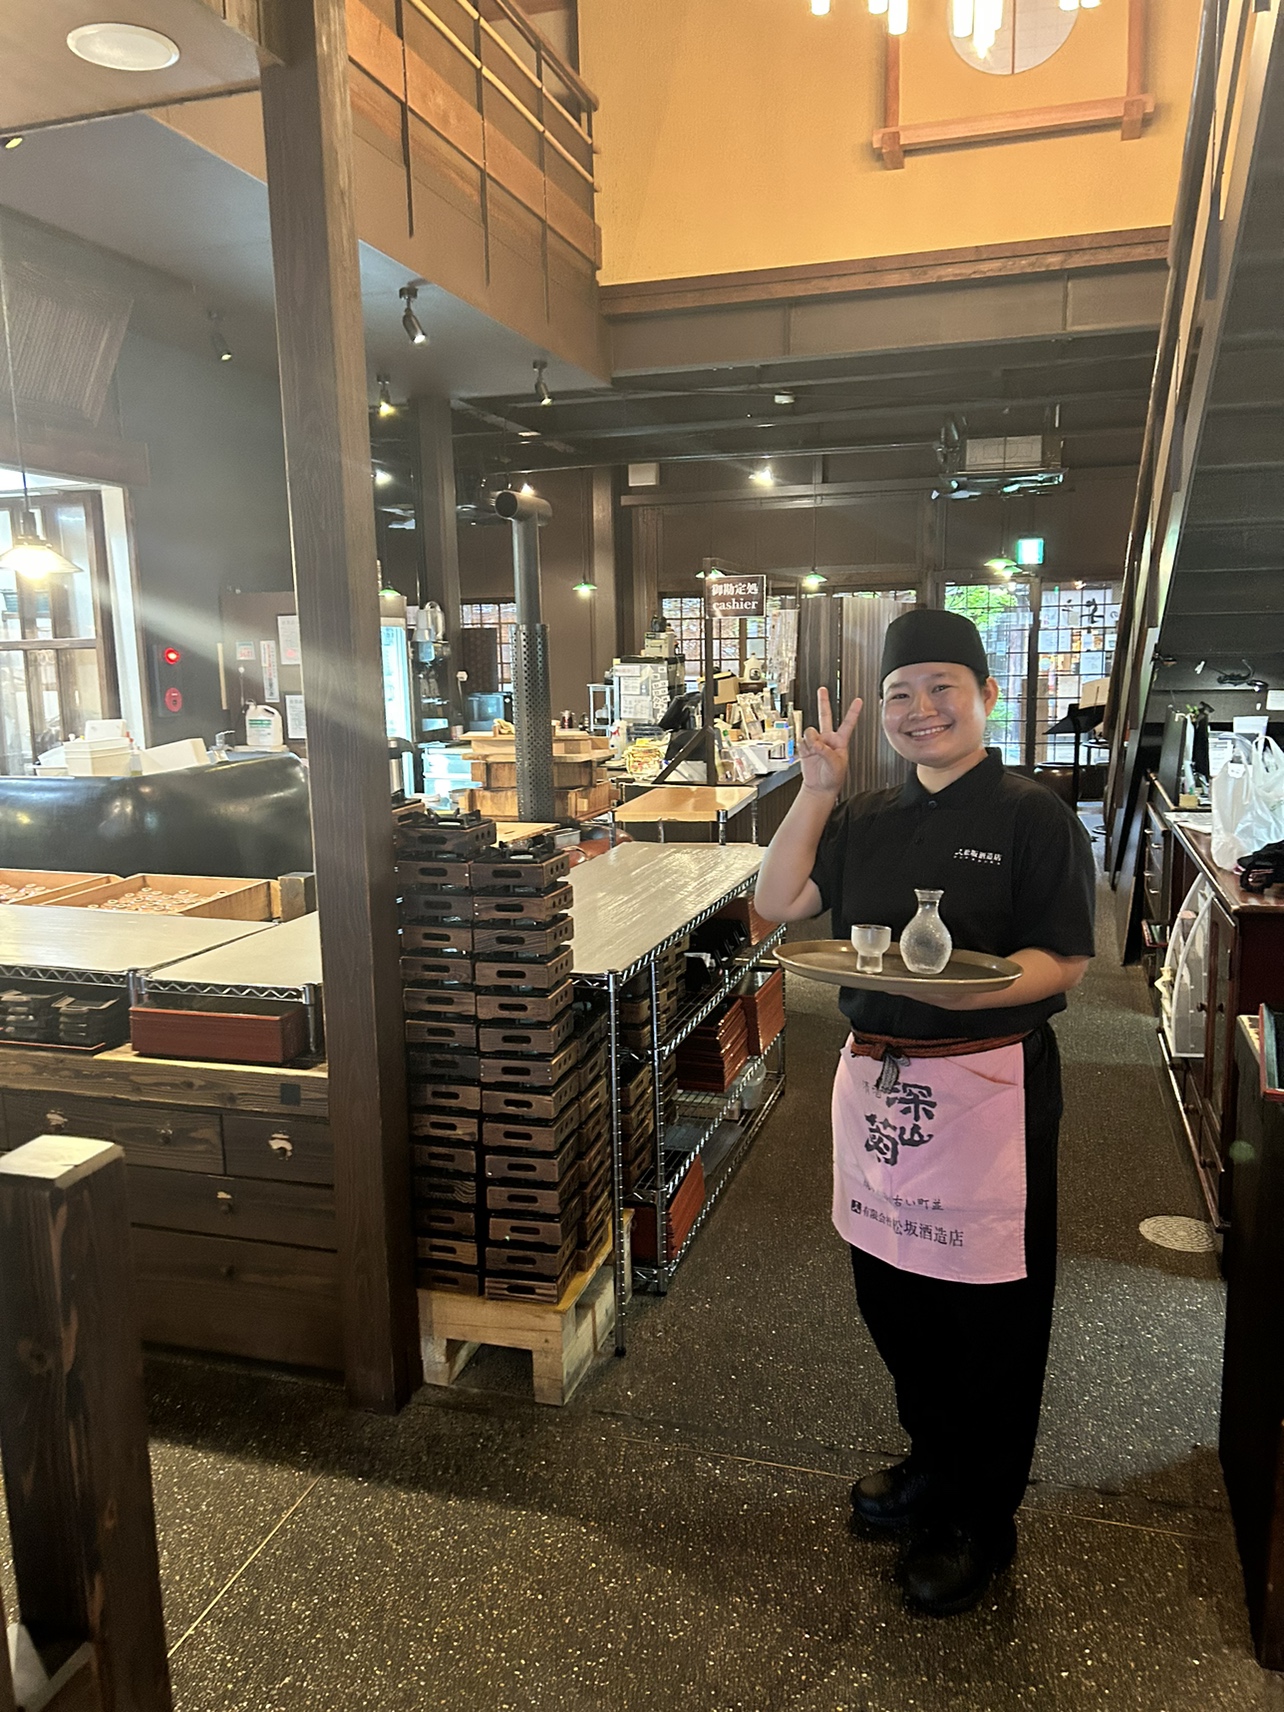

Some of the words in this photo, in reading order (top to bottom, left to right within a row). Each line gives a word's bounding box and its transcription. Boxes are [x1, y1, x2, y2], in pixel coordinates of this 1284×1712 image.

[711, 582, 759, 596] 御勘定処
[712, 598, 759, 610] cashier
